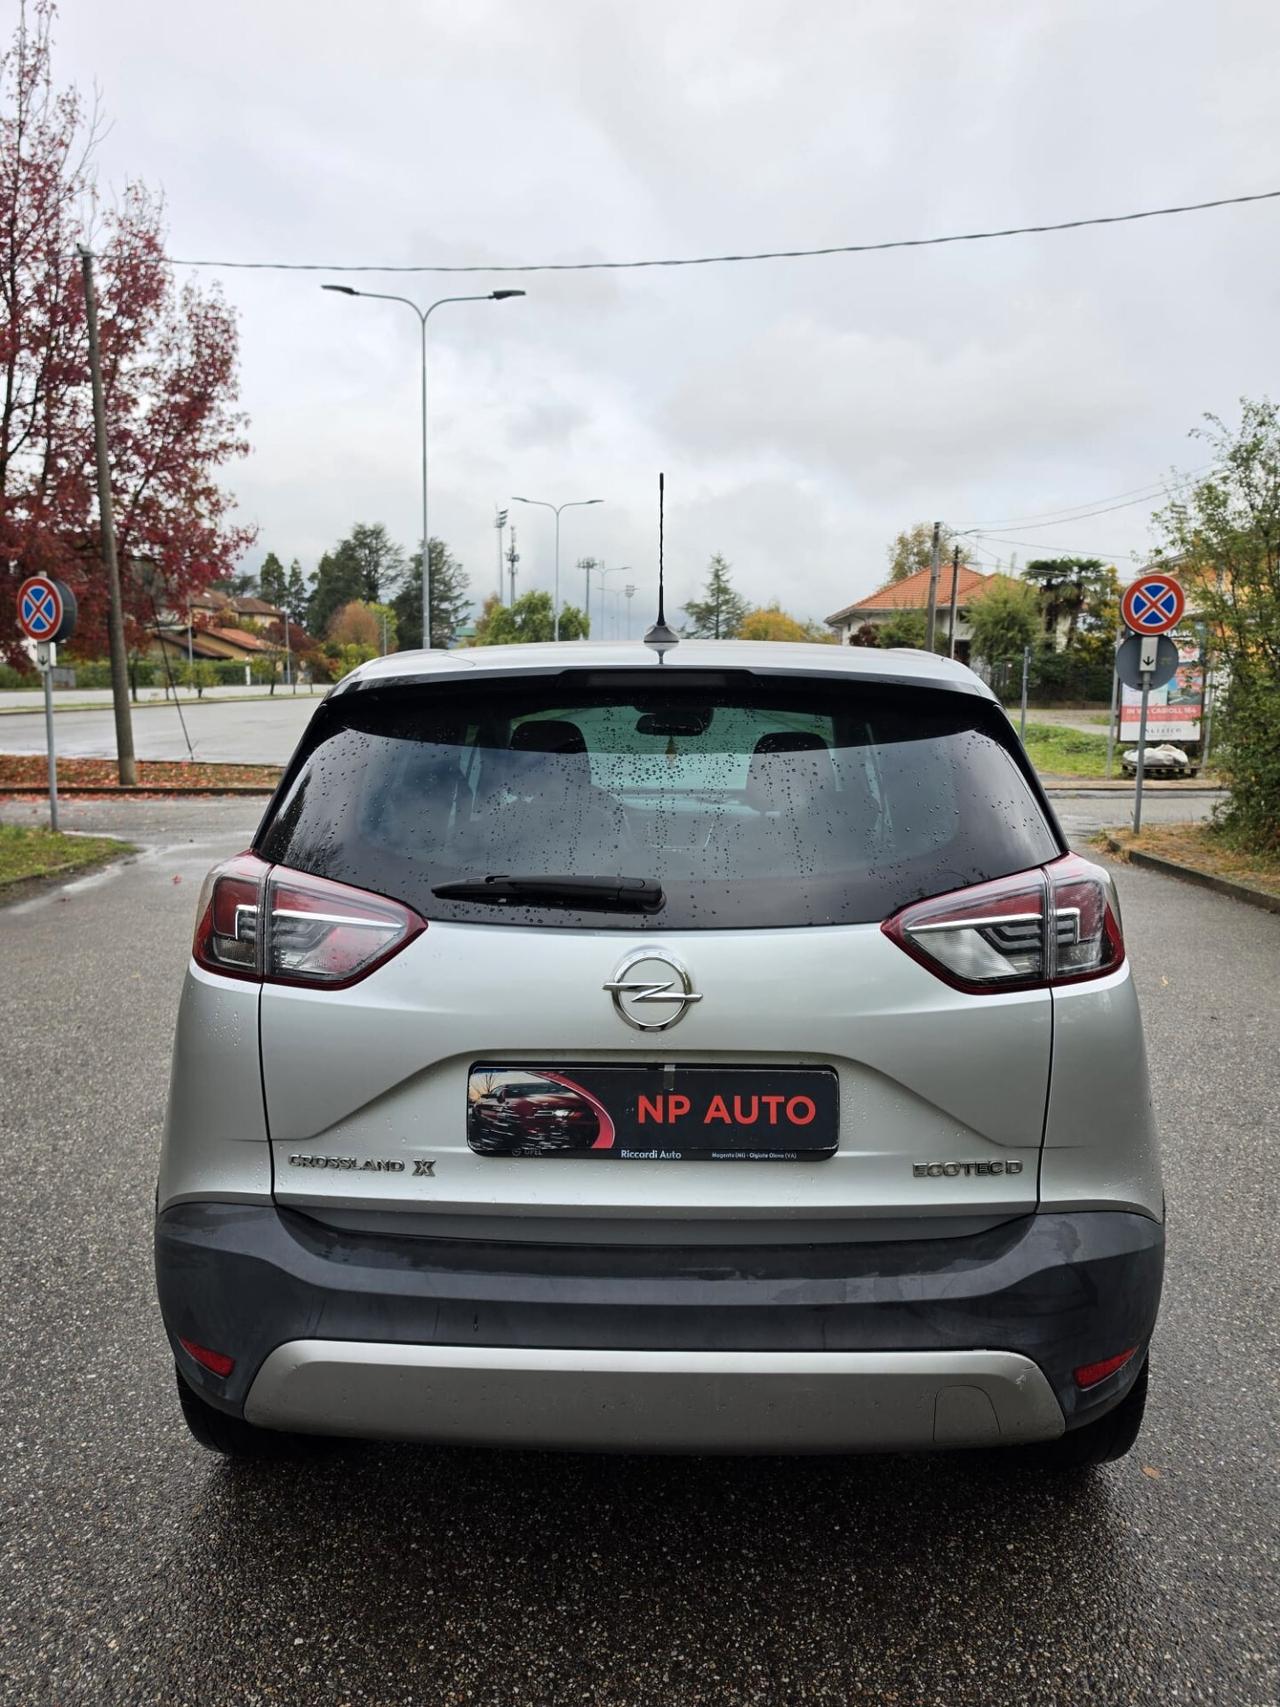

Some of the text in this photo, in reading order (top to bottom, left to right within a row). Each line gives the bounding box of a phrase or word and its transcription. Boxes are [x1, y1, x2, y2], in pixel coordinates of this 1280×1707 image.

[638, 1095, 816, 1125] NP AUTO
[288, 1154, 436, 1177] CROSSLAND X
[621, 1149, 681, 1159] Riccardi Auto
